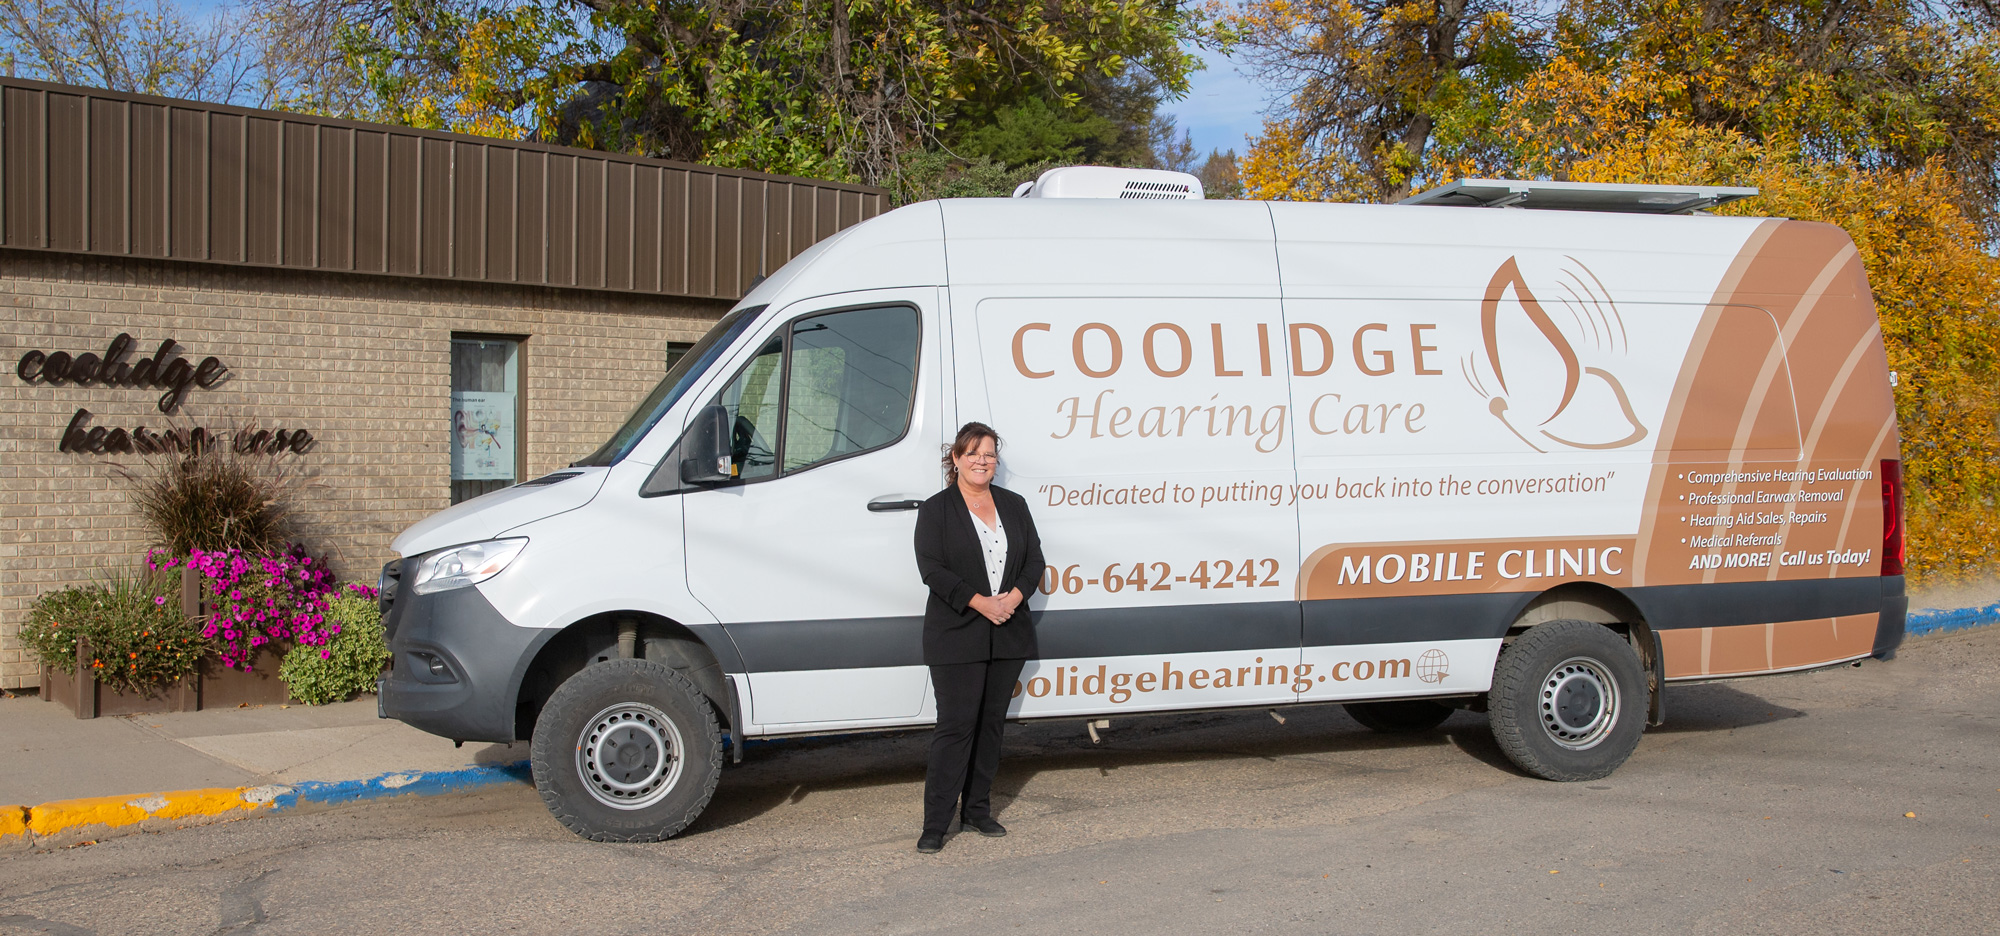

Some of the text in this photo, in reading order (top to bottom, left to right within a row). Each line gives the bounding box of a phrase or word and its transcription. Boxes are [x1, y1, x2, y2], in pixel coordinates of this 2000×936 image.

[1011, 322, 1443, 379] COOLIDGE
[17, 332, 229, 413] coolidge
[1050, 389, 1427, 453] Hearing Care
[1039, 471, 1615, 508] “Dedicated to putting you back into the conversation”
[1687, 468, 1873, 486] Comprehensive Hearing Evaluation
[1688, 488, 1844, 505] Professional Earwax Removal
[1690, 510, 1827, 529] Hearing Aid Sales, Repairs
[1690, 532, 1782, 548] Medical Referrals
[1337, 547, 1623, 585] MOBILE CLINIC
[1689, 549, 1871, 570] AND MORE! Call us Today!
